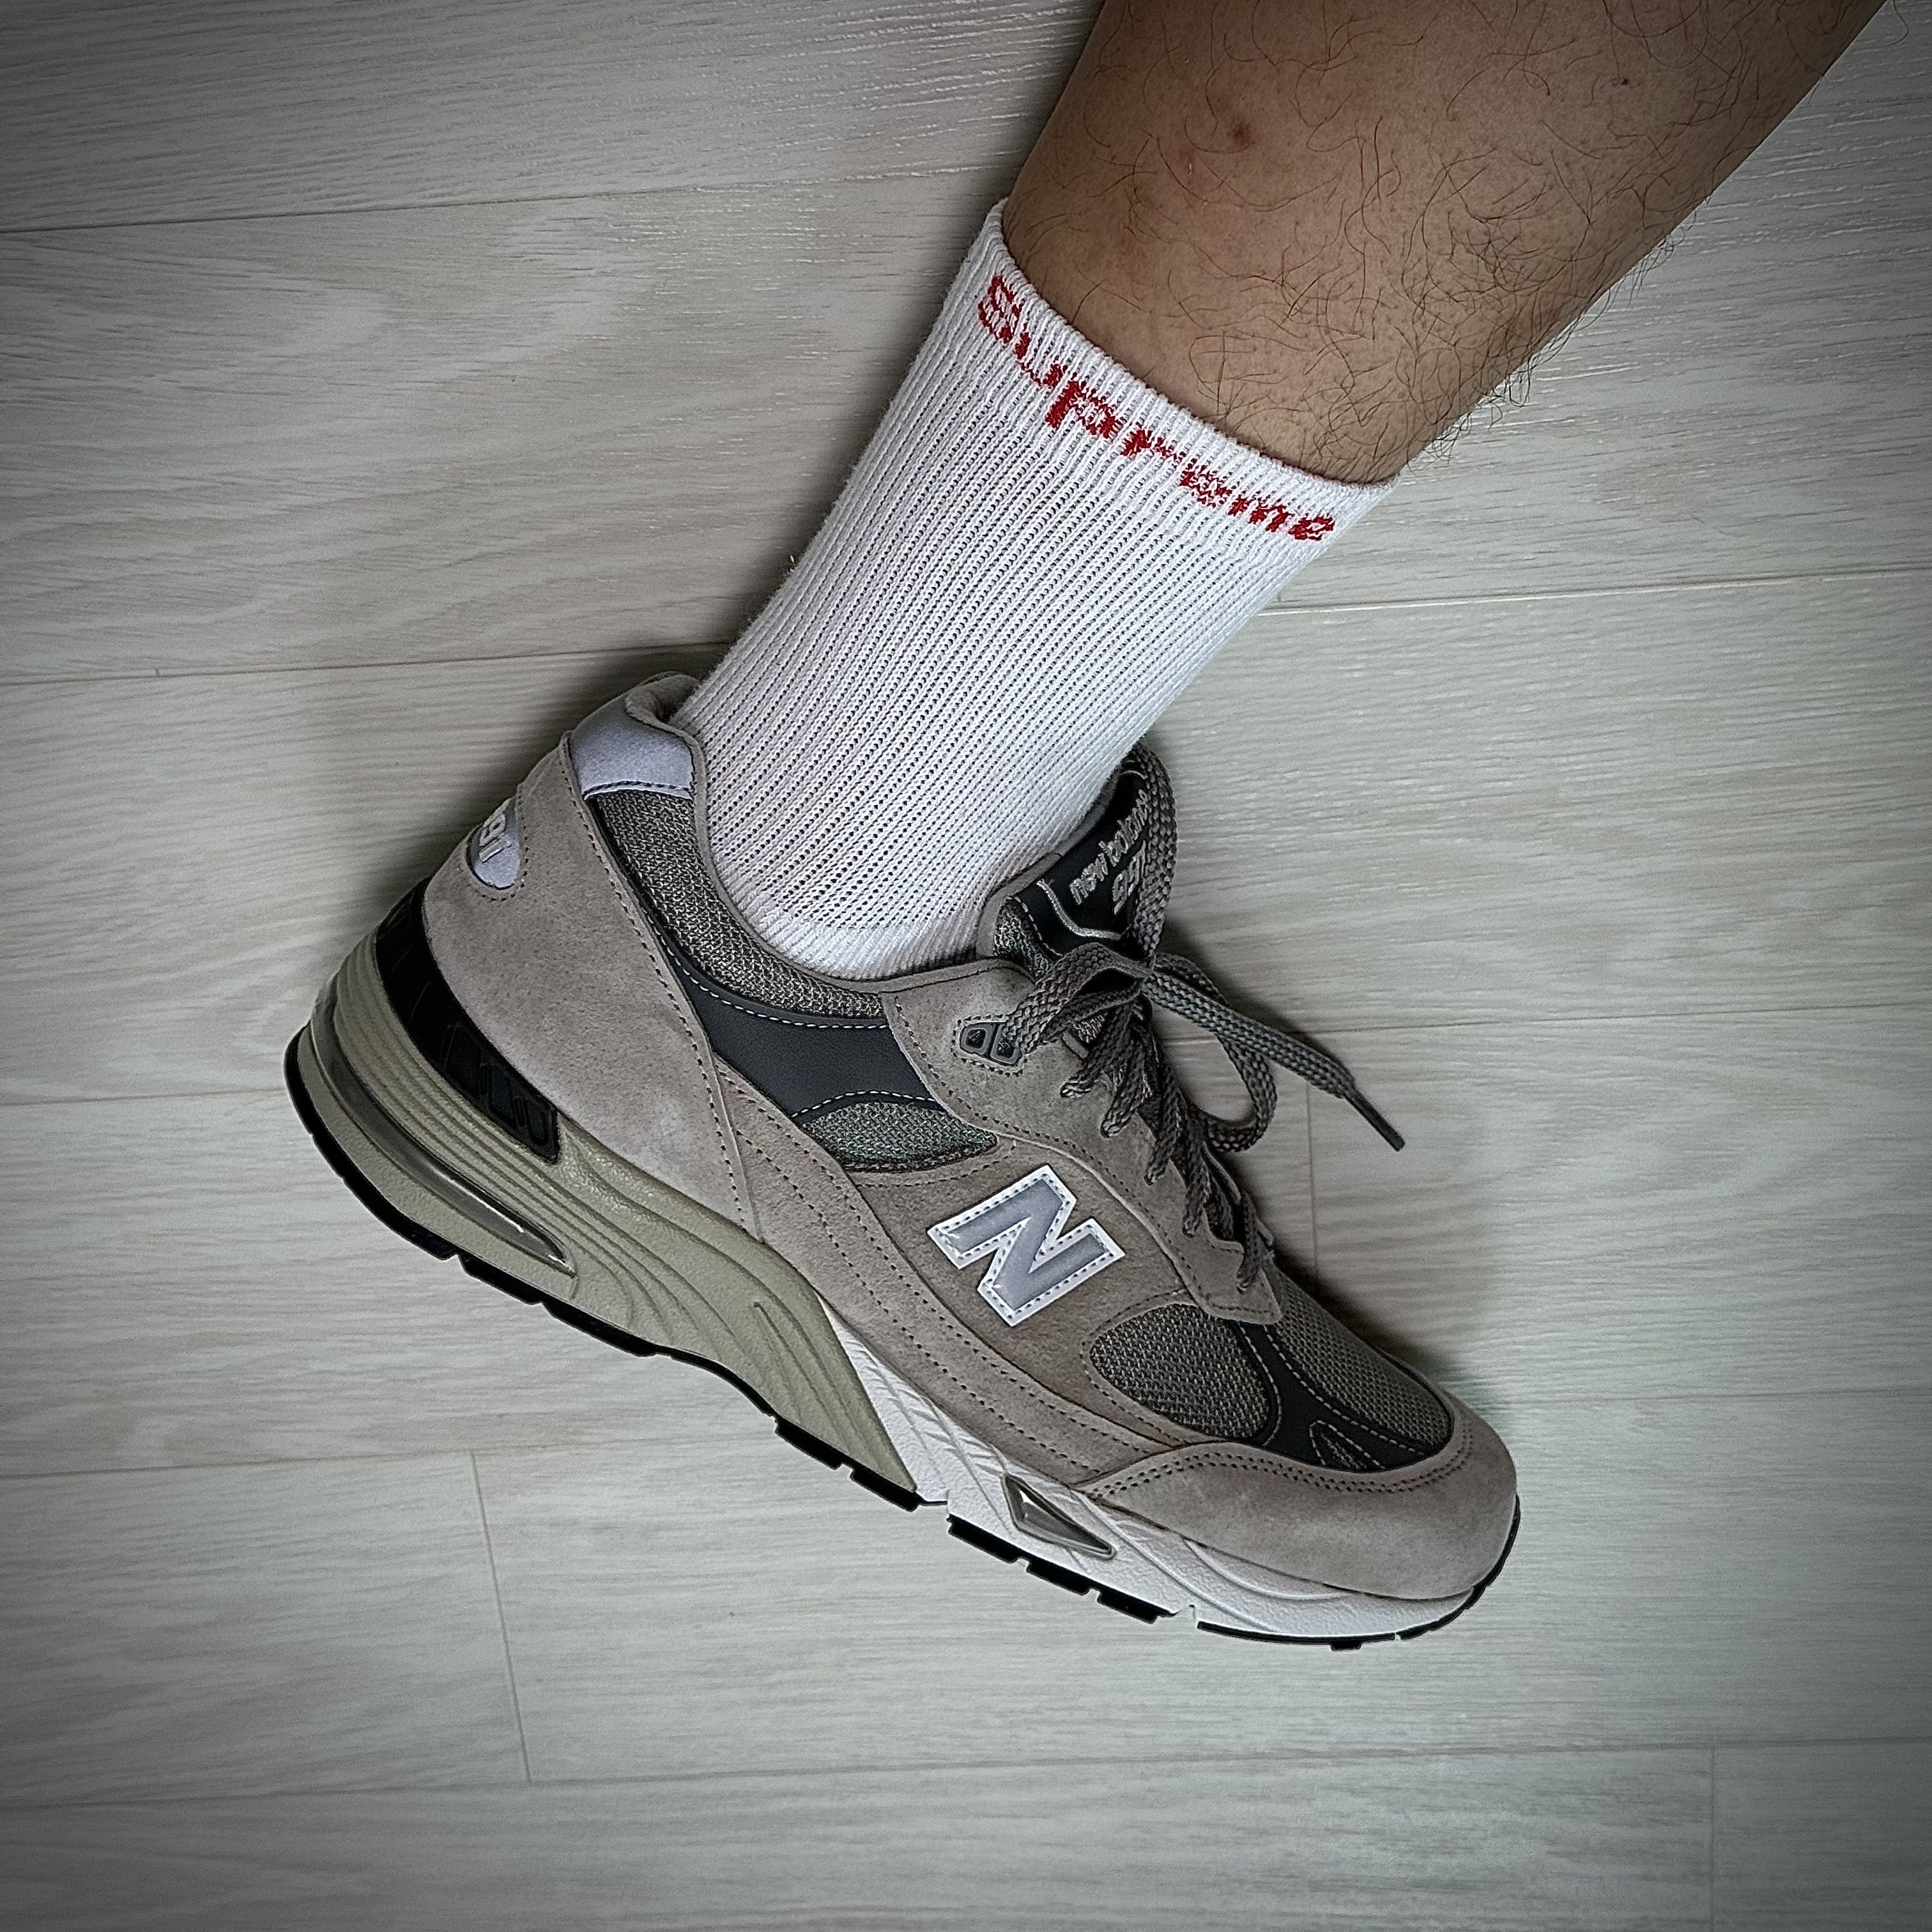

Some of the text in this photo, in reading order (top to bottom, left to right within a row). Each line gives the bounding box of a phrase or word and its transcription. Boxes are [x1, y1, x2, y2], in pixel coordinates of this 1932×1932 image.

[978, 275, 1334, 541] Supreme
[480, 799, 513, 863] 91
[1070, 852, 1108, 905] new
[927, 1163, 1126, 1327] N
